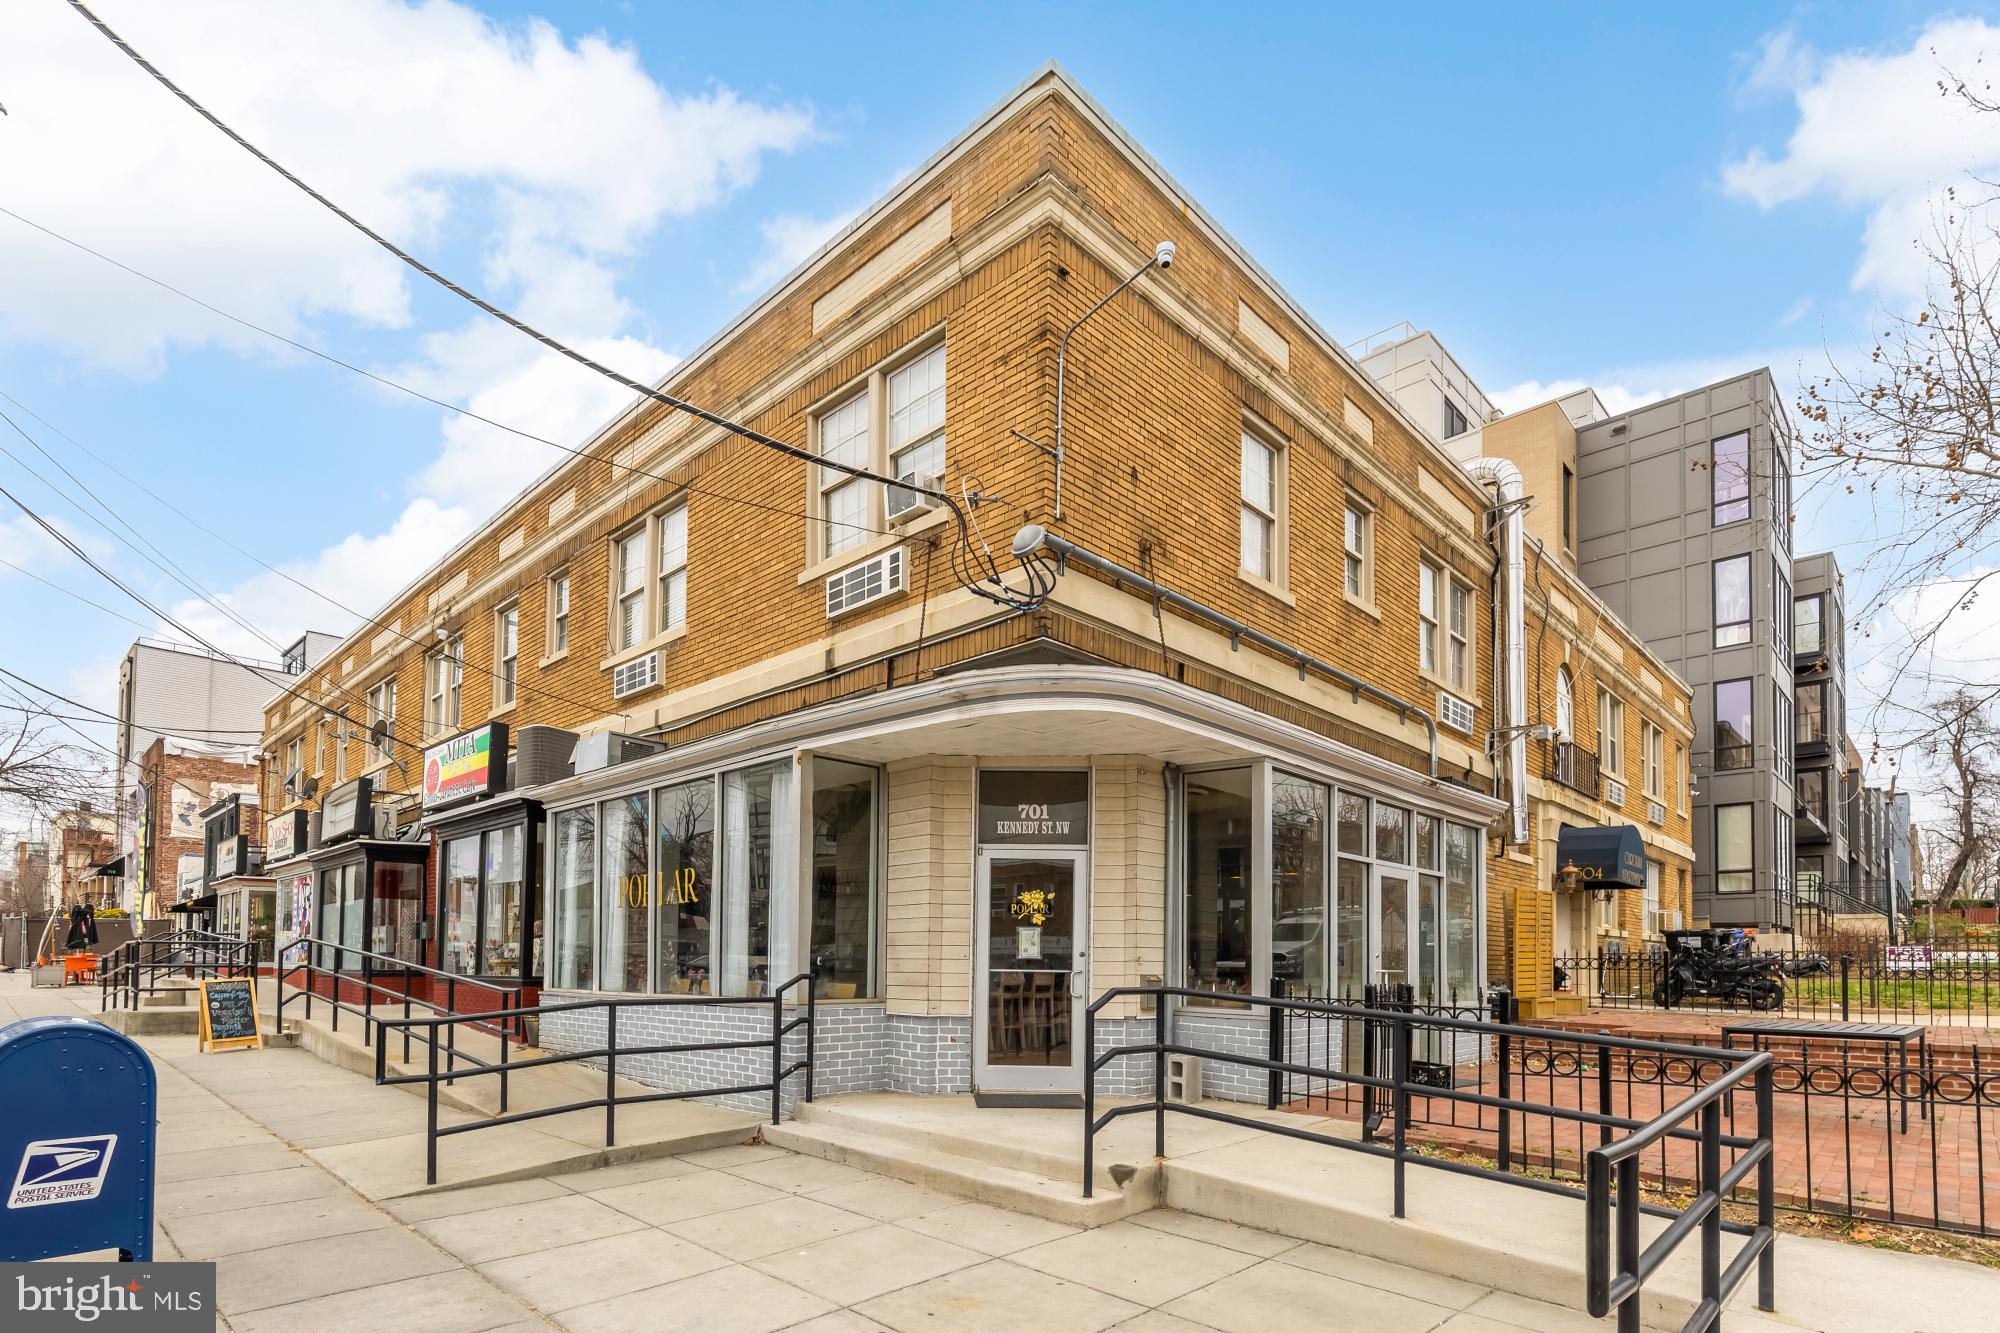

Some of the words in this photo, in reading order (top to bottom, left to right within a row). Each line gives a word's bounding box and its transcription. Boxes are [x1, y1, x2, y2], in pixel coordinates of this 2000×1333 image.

[446, 734, 476, 764] MITA
[1018, 804, 1049, 819] 701
[997, 821, 1040, 834] KENNEDY
[1056, 821, 1070, 834] NW
[14, 1192, 53, 1204] POSTAL
[54, 1188, 95, 1200] SERVICE
[17, 1186, 57, 1197] UNITED
[58, 1182, 92, 1192] STATES
